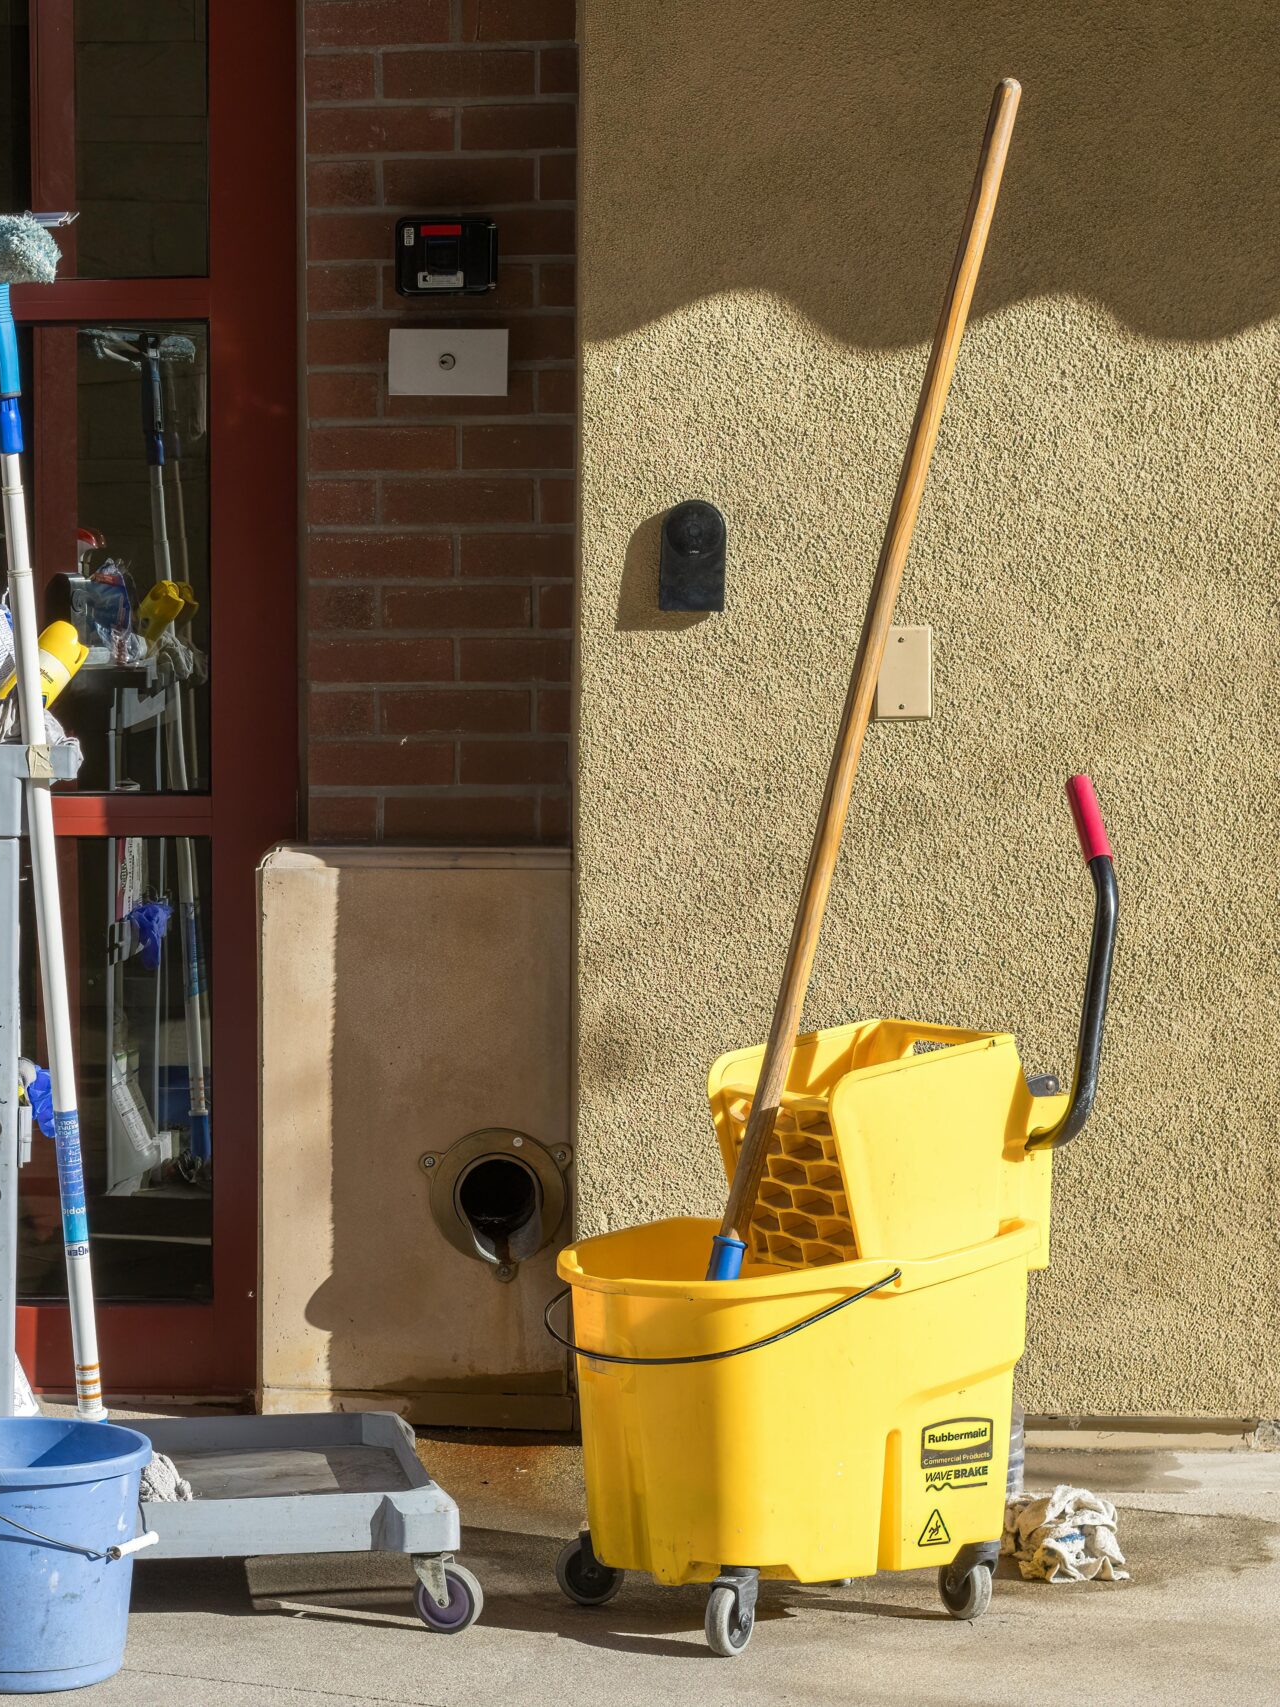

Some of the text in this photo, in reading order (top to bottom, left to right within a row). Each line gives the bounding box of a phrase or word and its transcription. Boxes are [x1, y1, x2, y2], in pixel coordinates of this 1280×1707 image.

[67, 1246, 88, 1256] NGER
[927, 1427, 988, 1444] Rubbermaid
[923, 1451, 990, 1466] Commercial Products
